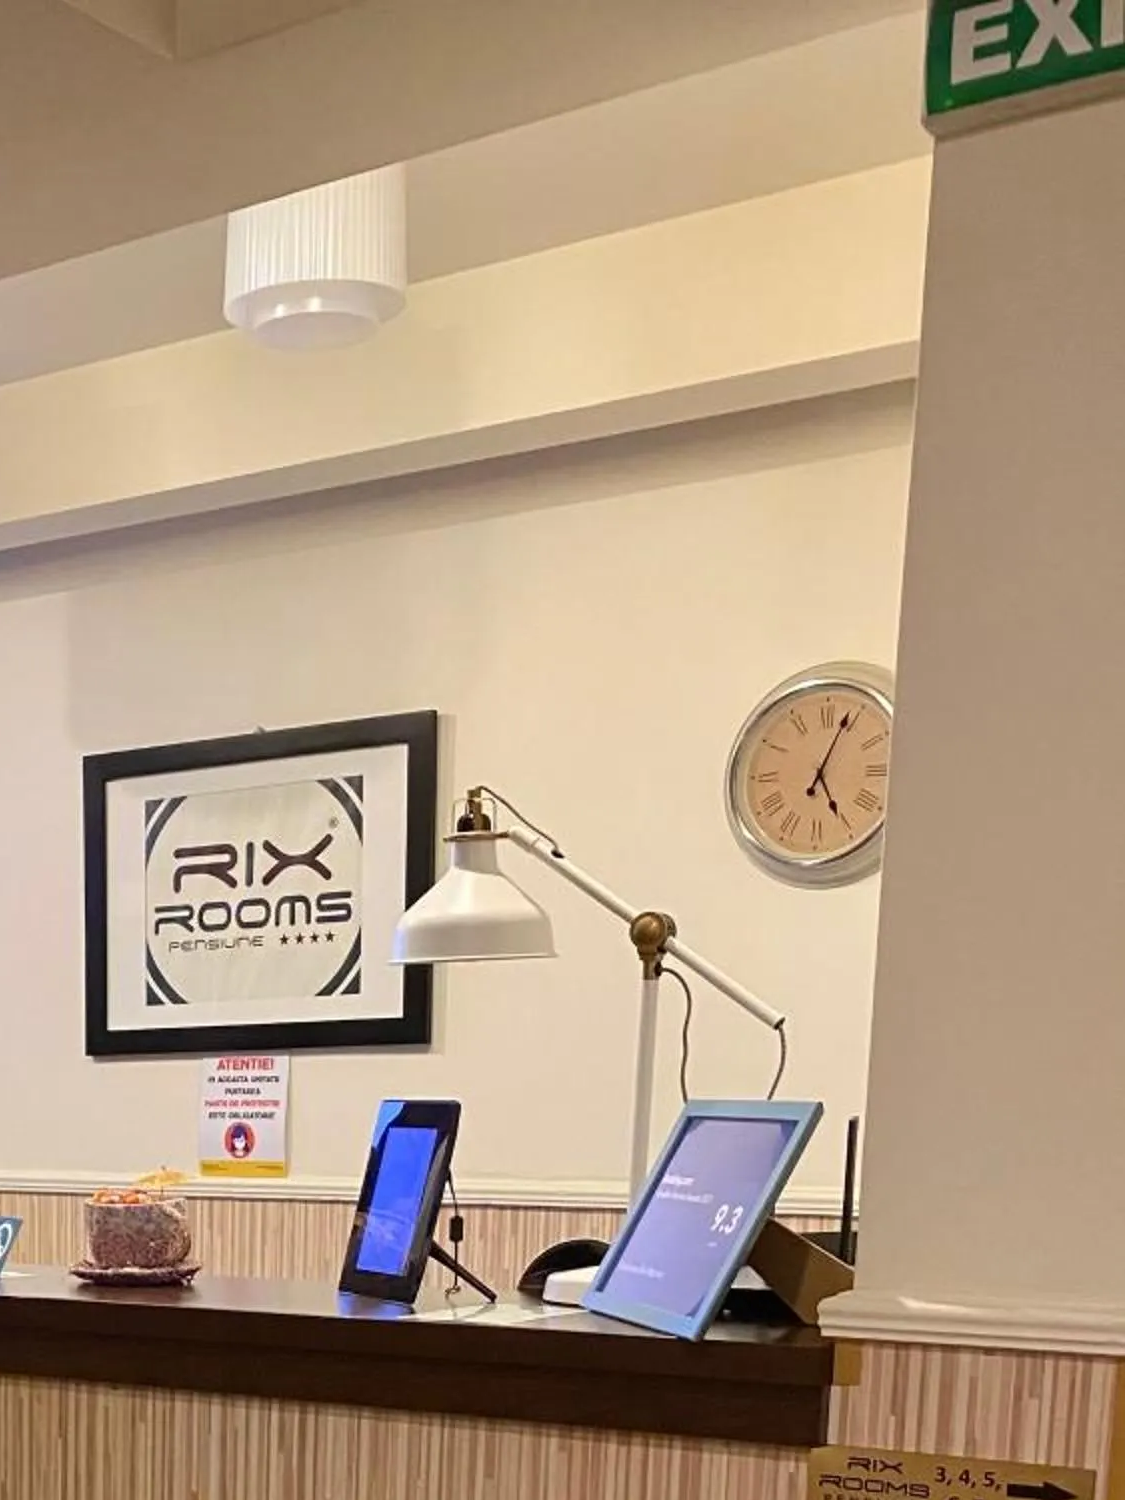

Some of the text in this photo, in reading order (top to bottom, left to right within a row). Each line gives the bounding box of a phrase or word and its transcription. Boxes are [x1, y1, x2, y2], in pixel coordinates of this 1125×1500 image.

[173, 833, 334, 893] RIX
[154, 890, 353, 936] ROOMS
[168, 935, 265, 953] PENSIUNE
[847, 1455, 904, 1474] RIX
[819, 1474, 931, 1500] ROOMS
